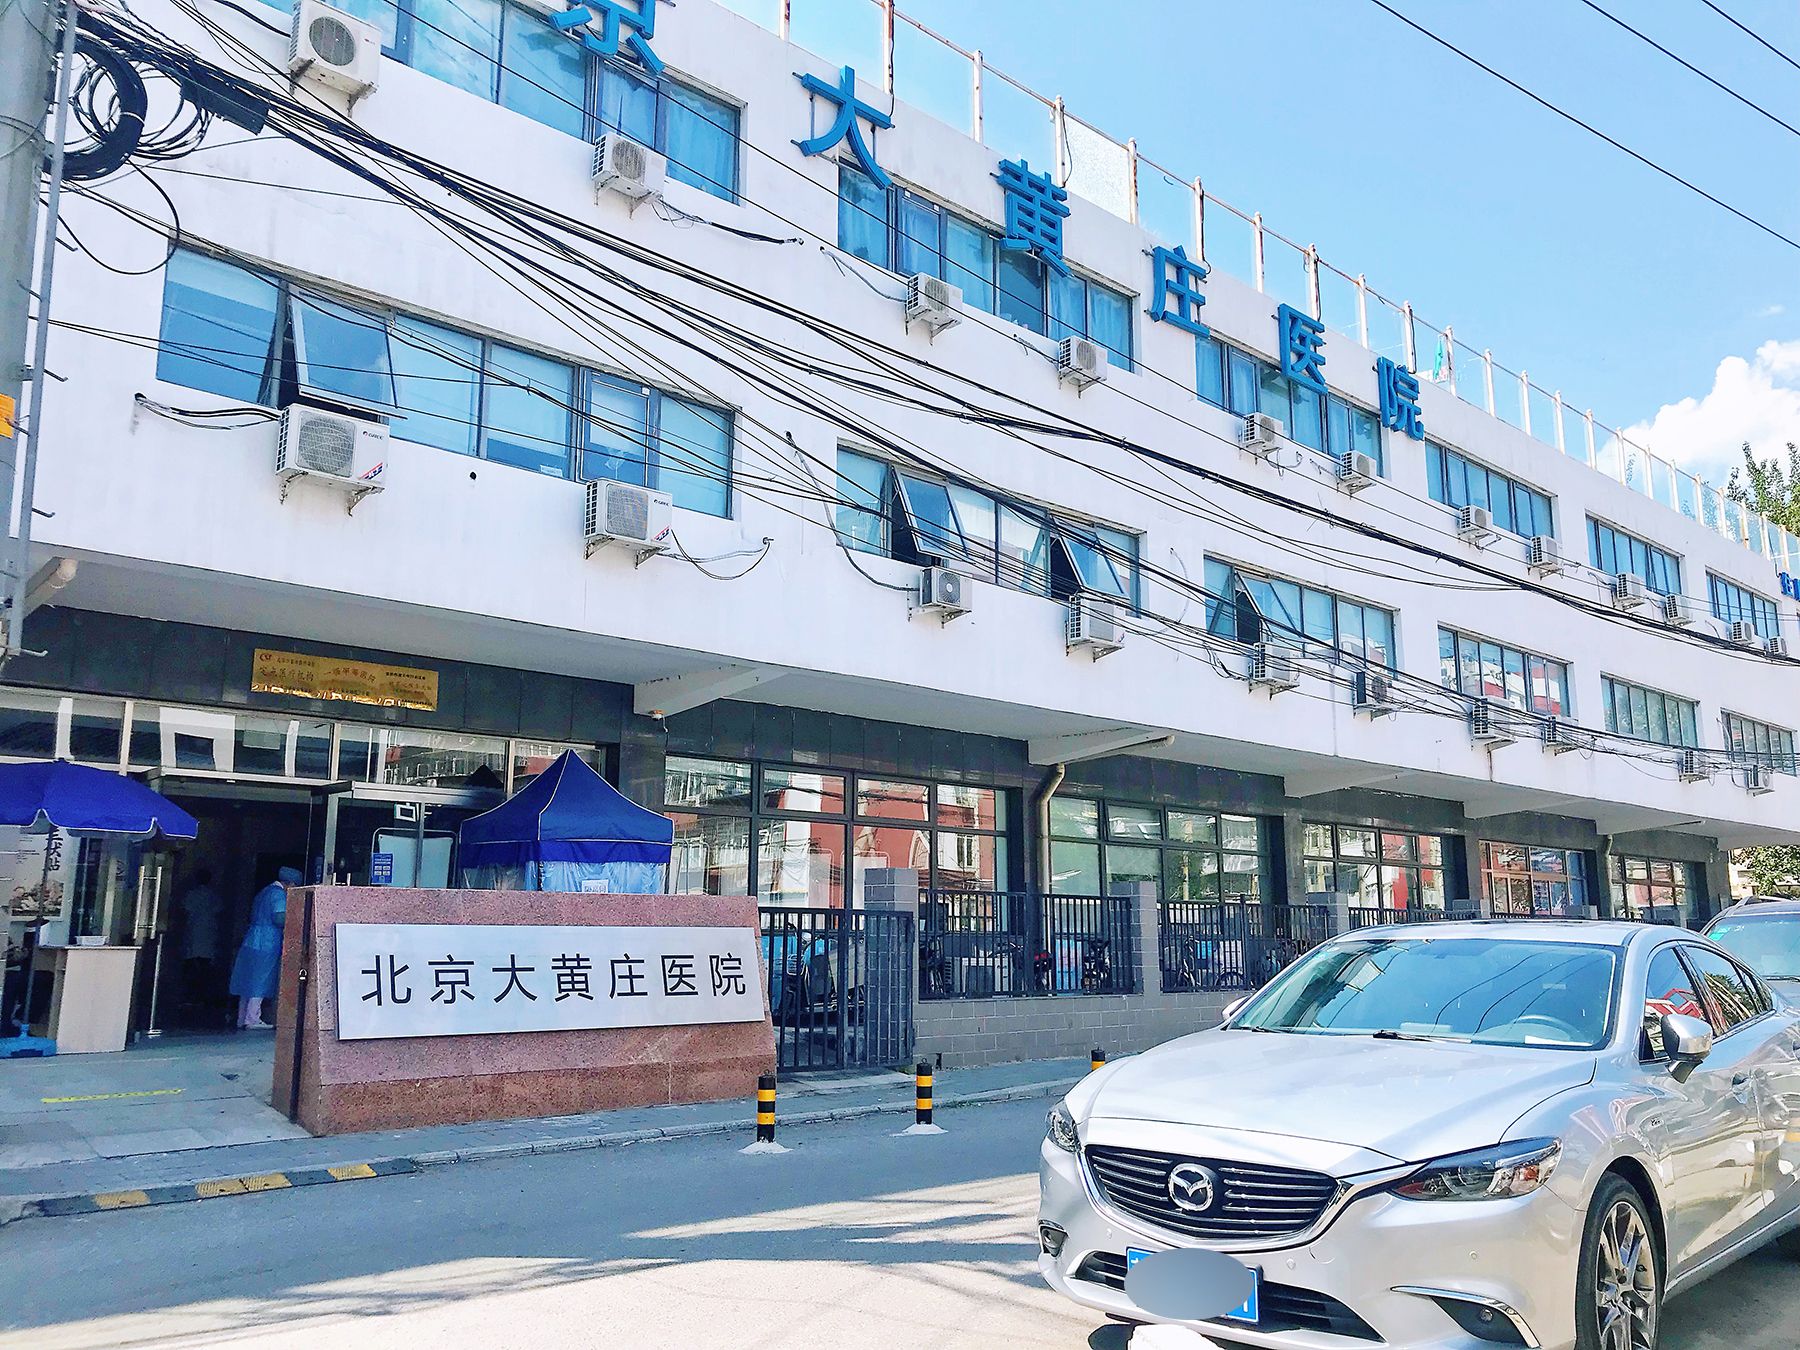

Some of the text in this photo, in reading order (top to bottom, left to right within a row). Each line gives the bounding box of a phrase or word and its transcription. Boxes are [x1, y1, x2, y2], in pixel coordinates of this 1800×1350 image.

[361, 952, 746, 1006] 北京大黄庄医院
